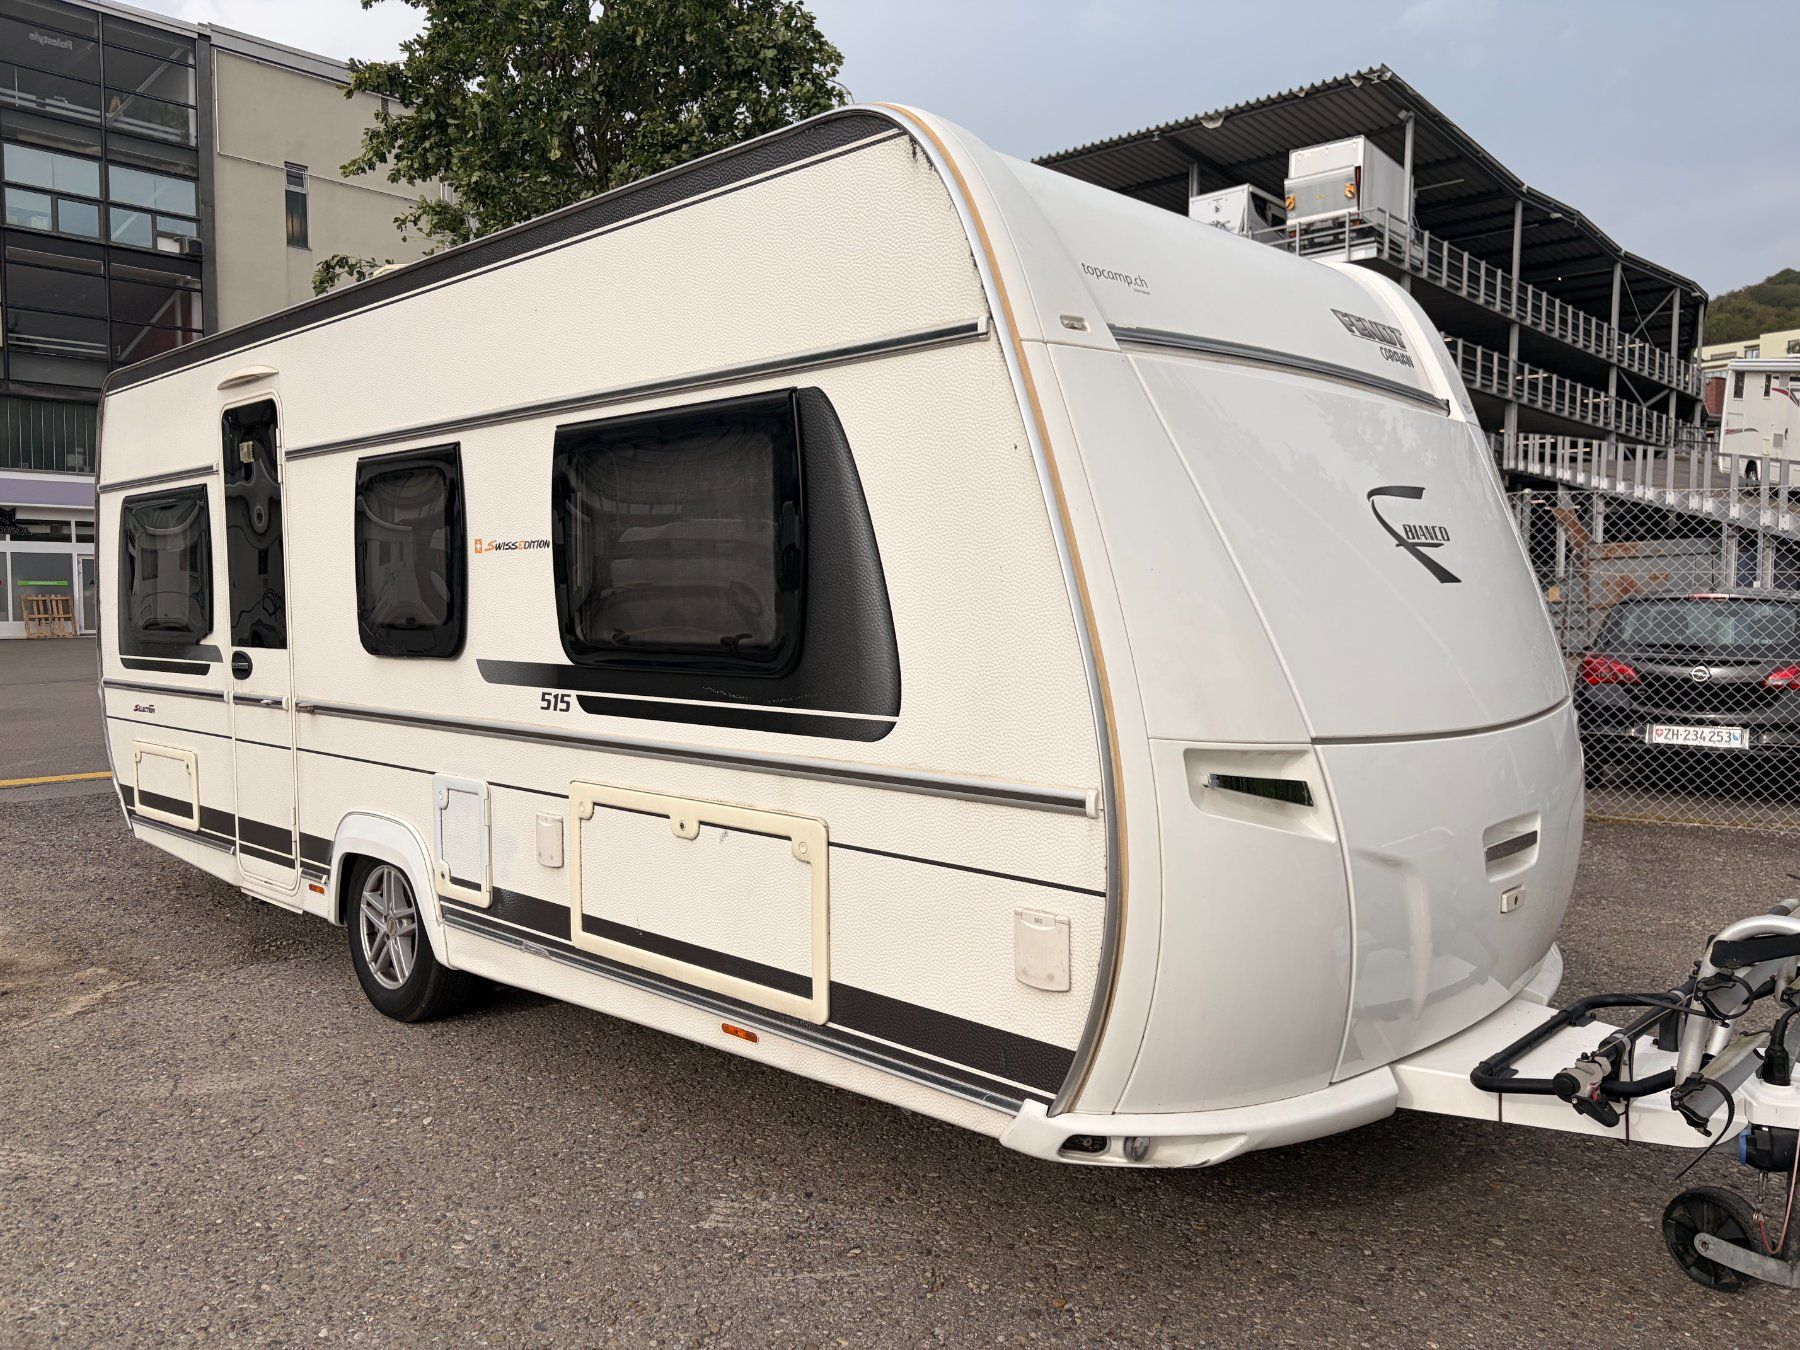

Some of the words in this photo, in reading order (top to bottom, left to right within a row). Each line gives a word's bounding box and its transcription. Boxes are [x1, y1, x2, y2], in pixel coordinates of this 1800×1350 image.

[1081, 262, 1149, 289] topcamp.ch
[1330, 308, 1407, 350] FENDT
[1402, 524, 1451, 542] BIANCO
[540, 691, 572, 713] 515
